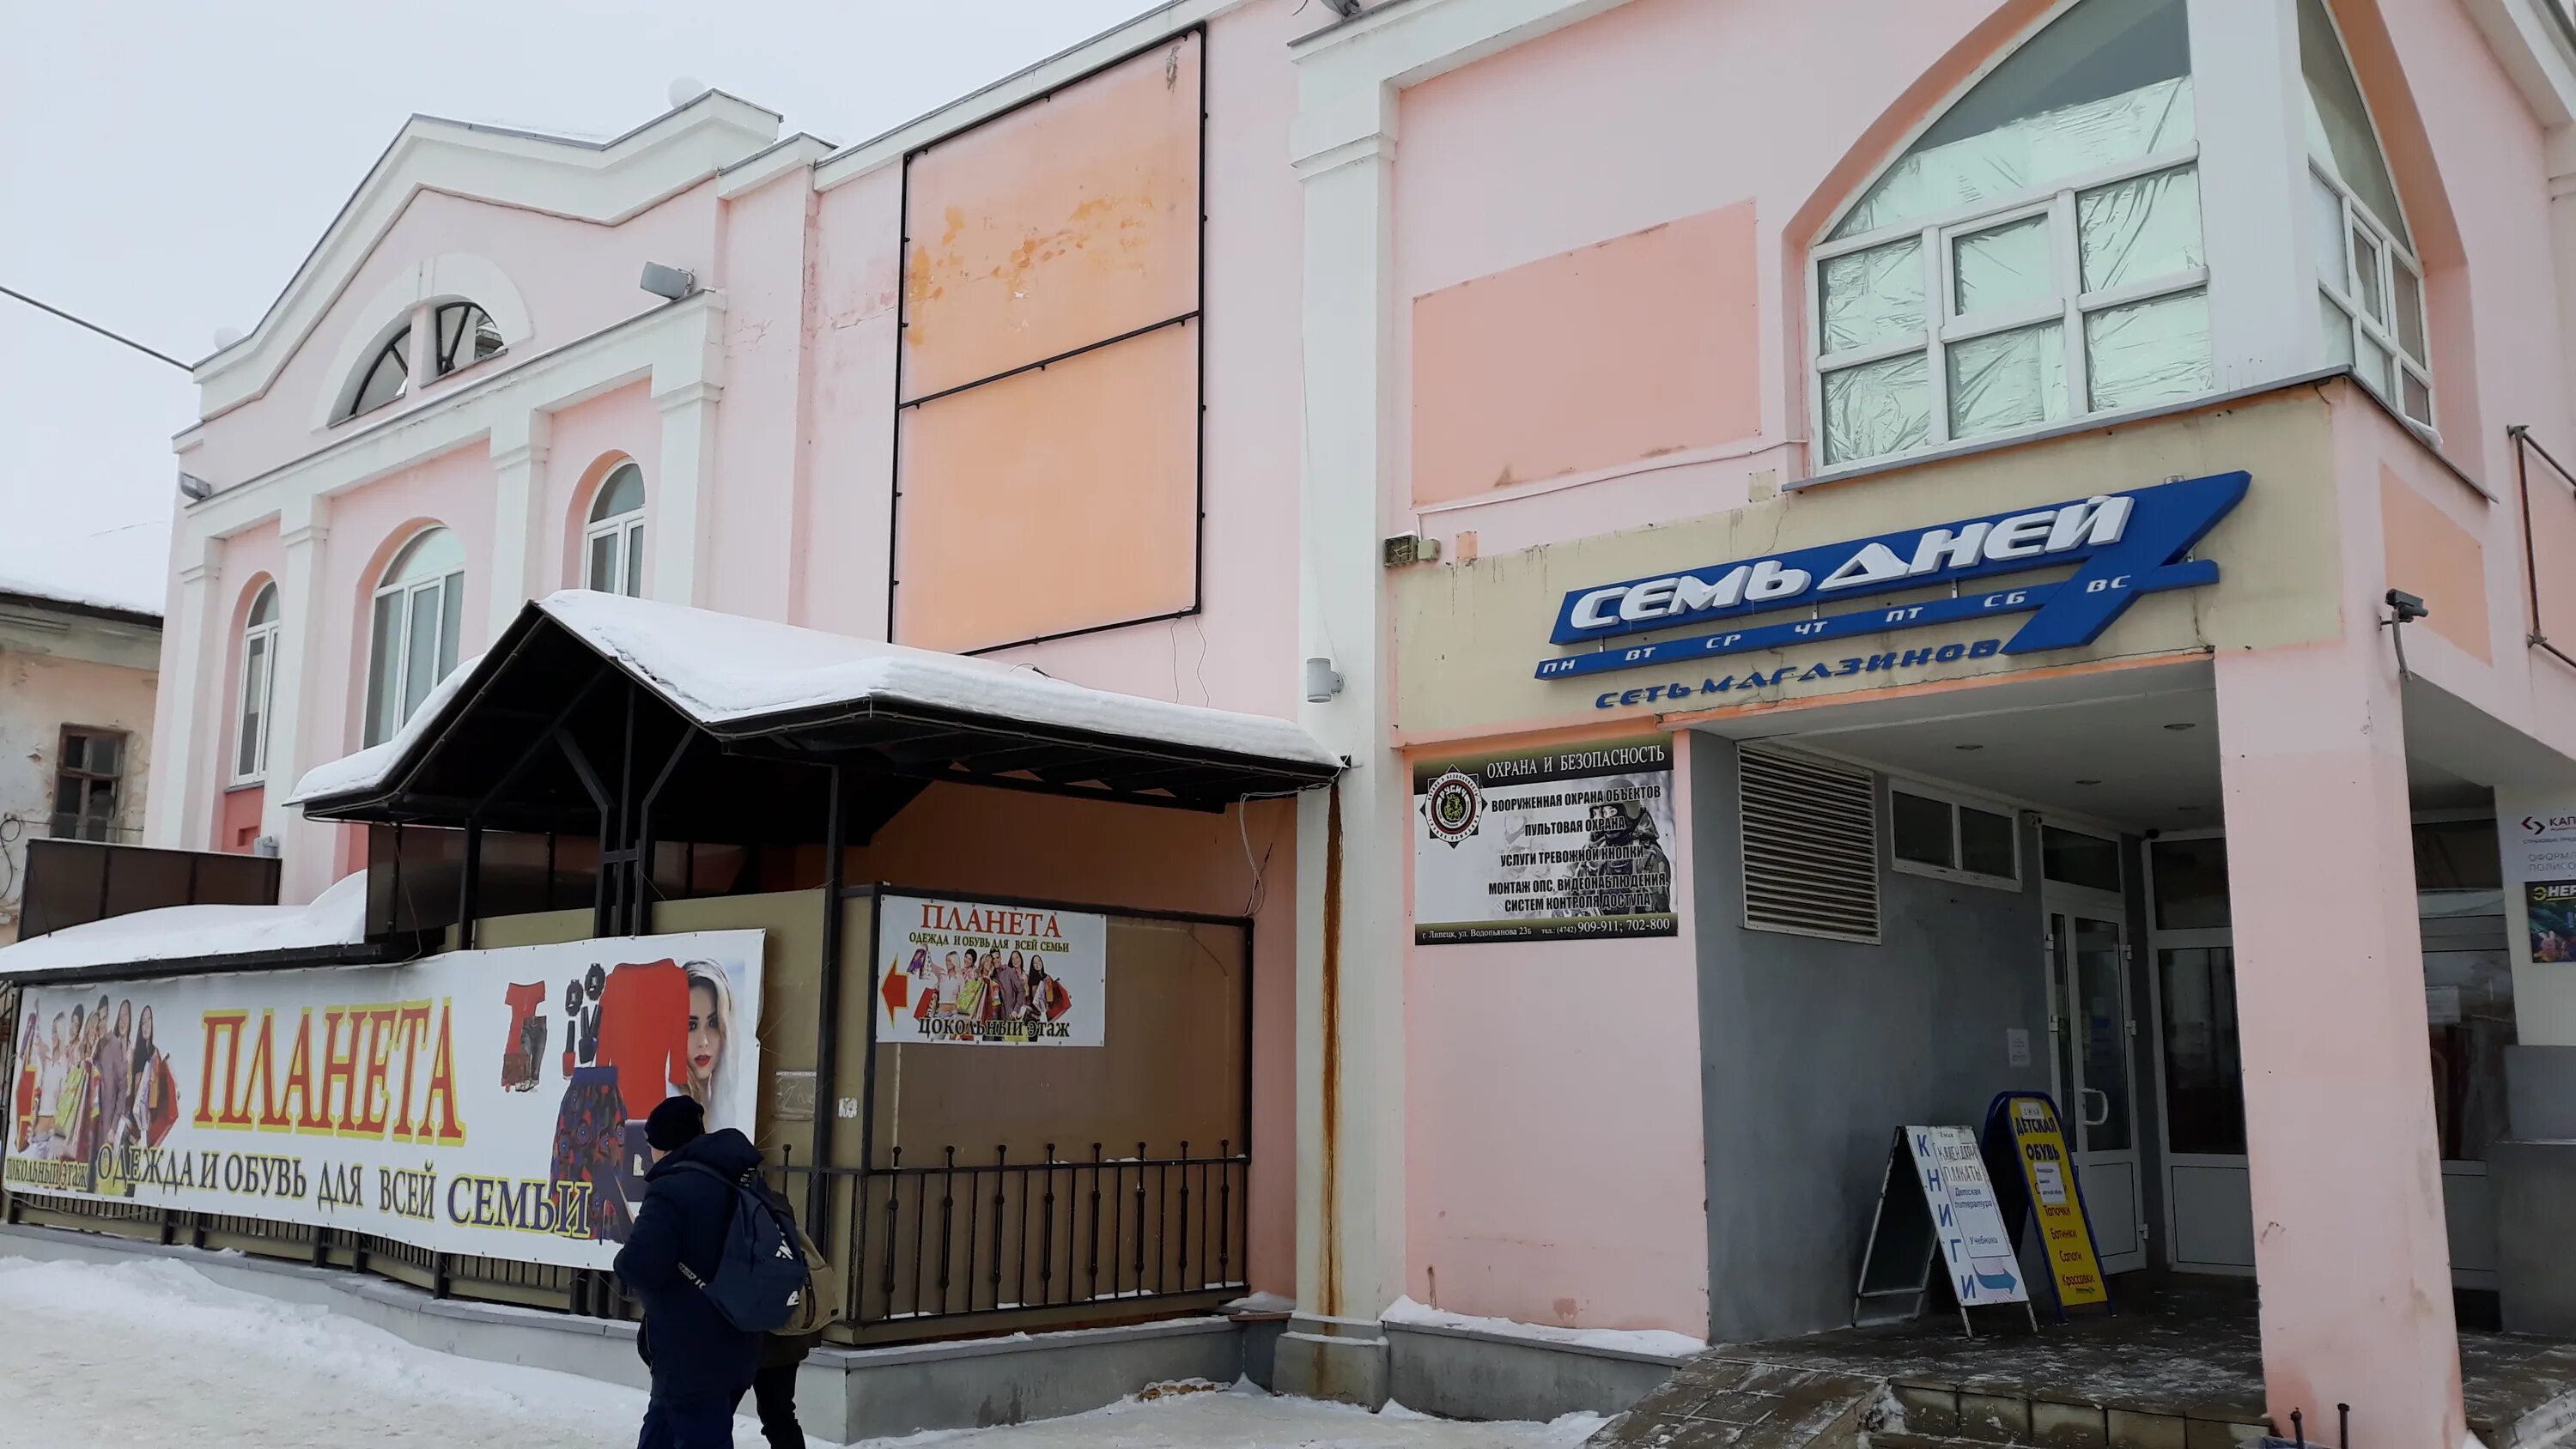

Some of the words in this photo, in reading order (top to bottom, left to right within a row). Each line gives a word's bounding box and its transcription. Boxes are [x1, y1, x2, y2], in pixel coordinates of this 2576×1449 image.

[1571, 559, 1811, 630] СЕМЬ
[1817, 494, 2135, 592] ДНЕЙ
[1542, 658, 1577, 674] ПН
[1625, 646, 1656, 662] ВТ
[1705, 634, 1742, 651] СР
[1794, 621, 1828, 635] ЧТ
[1886, 607, 1923, 622] ПТ
[1984, 591, 2026, 609] СБ
[2087, 575, 2130, 592] ВС
[1595, 682, 1691, 709] СЕТЬ
[1700, 639, 2002, 692] МАГАЗИНОВ
[1487, 759, 1538, 779] ОХРАНА
[1544, 756, 1552, 773] И
[1560, 744, 1665, 771] БЕЗОПАСНОСТЬ
[1439, 785, 1467, 798] РУСИЧ
[1492, 794, 1562, 812] ВООРУЖЕННАЯ
[1564, 790, 1603, 806] ОХРАНА
[1607, 785, 1661, 802] ОБЪЕКТОВ
[1525, 820, 1583, 836] ПУЛЬТОВАЯ
[1585, 816, 1625, 832] ОХРАНА
[1501, 852, 1536, 867] УСЛУГИ
[1539, 846, 1599, 864] ТРЕВОЖНОЙ
[1601, 845, 1643, 860] КНОПКИ
[1489, 880, 1531, 894] МОНТАЖ
[1533, 878, 1556, 893] ОПС,
[1558, 872, 1668, 891] ВИДЕОНАБЛЮДЕНИЯ,
[1505, 898, 1544, 912] СИСТЕМ
[1546, 895, 1600, 910] КОНТРОЛЯ
[1601, 893, 1650, 909] ДОСТУПА
[920, 904, 1061, 938] ПЛАНЕТА
[1429, 930, 1457, 939] Липецк,
[1458, 931, 1468, 939] ул.
[1470, 928, 1517, 937] Водопьянова
[1557, 925, 1577, 935] (4742)
[1578, 919, 1623, 933] 909-911;
[1626, 918, 1670, 931] 702-800
[909, 931, 949, 946] ОДЕЖДА
[954, 935, 962, 946] И
[963, 936, 989, 949] ОБУВЬ
[989, 938, 1009, 950] ДЛЯ
[1015, 938, 1037, 951] ВСЕЙ
[1040, 941, 1069, 953] СЕМЬИ
[193, 997, 465, 1146] ПЛАНЕТА
[2015, 1117, 2057, 1136] ДЕТСКАЯ
[2026, 1143, 2061, 1161] ОБУВЬ
[1943, 1165, 1983, 1182] ПЛАКАТЫ
[98, 1143, 192, 1195] ОДЕЖДА
[200, 1151, 219, 1190] И
[224, 1153, 307, 1199] ОБУВЬ
[318, 1161, 362, 1213] ДЛЯ
[380, 1163, 436, 1221] ВСЕЙ
[448, 1174, 592, 1238] СЕМЬИ
[2044, 1205, 2071, 1216] Тапочки
[2050, 1228, 2078, 1240] Ботинки
[2060, 1250, 2083, 1263] Сапоги
